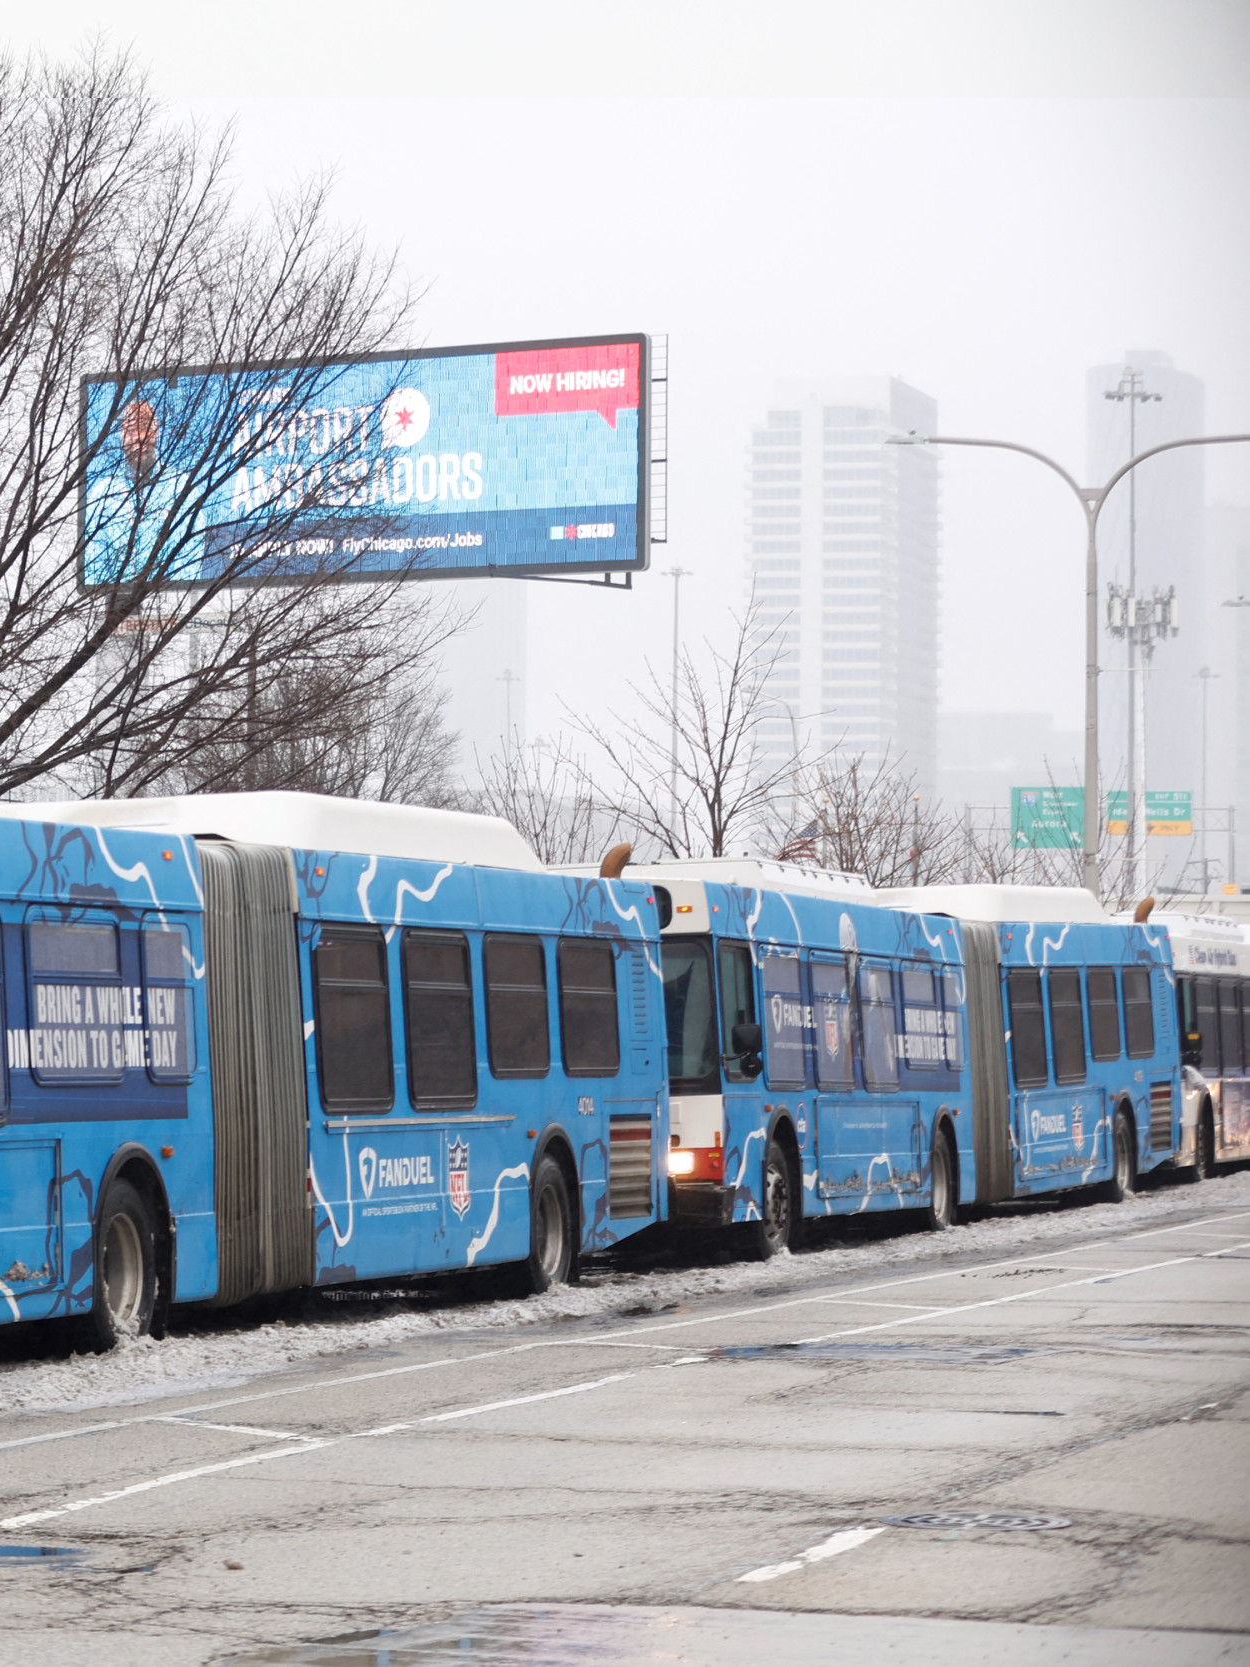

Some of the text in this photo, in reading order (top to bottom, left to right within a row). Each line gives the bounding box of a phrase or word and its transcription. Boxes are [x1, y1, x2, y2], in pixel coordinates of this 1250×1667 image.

[510, 368, 625, 394] NOW HIRING!
[234, 404, 376, 459] AIRPORT
[230, 451, 483, 512] AMBASSADORS
[36, 984, 82, 1024] BRING
[85, 985, 95, 1025] A
[147, 987, 176, 1025] NEW
[7, 1028, 178, 1069] DIMENSION TO GAME DAY
[378, 1156, 434, 1188] FANDUEL
